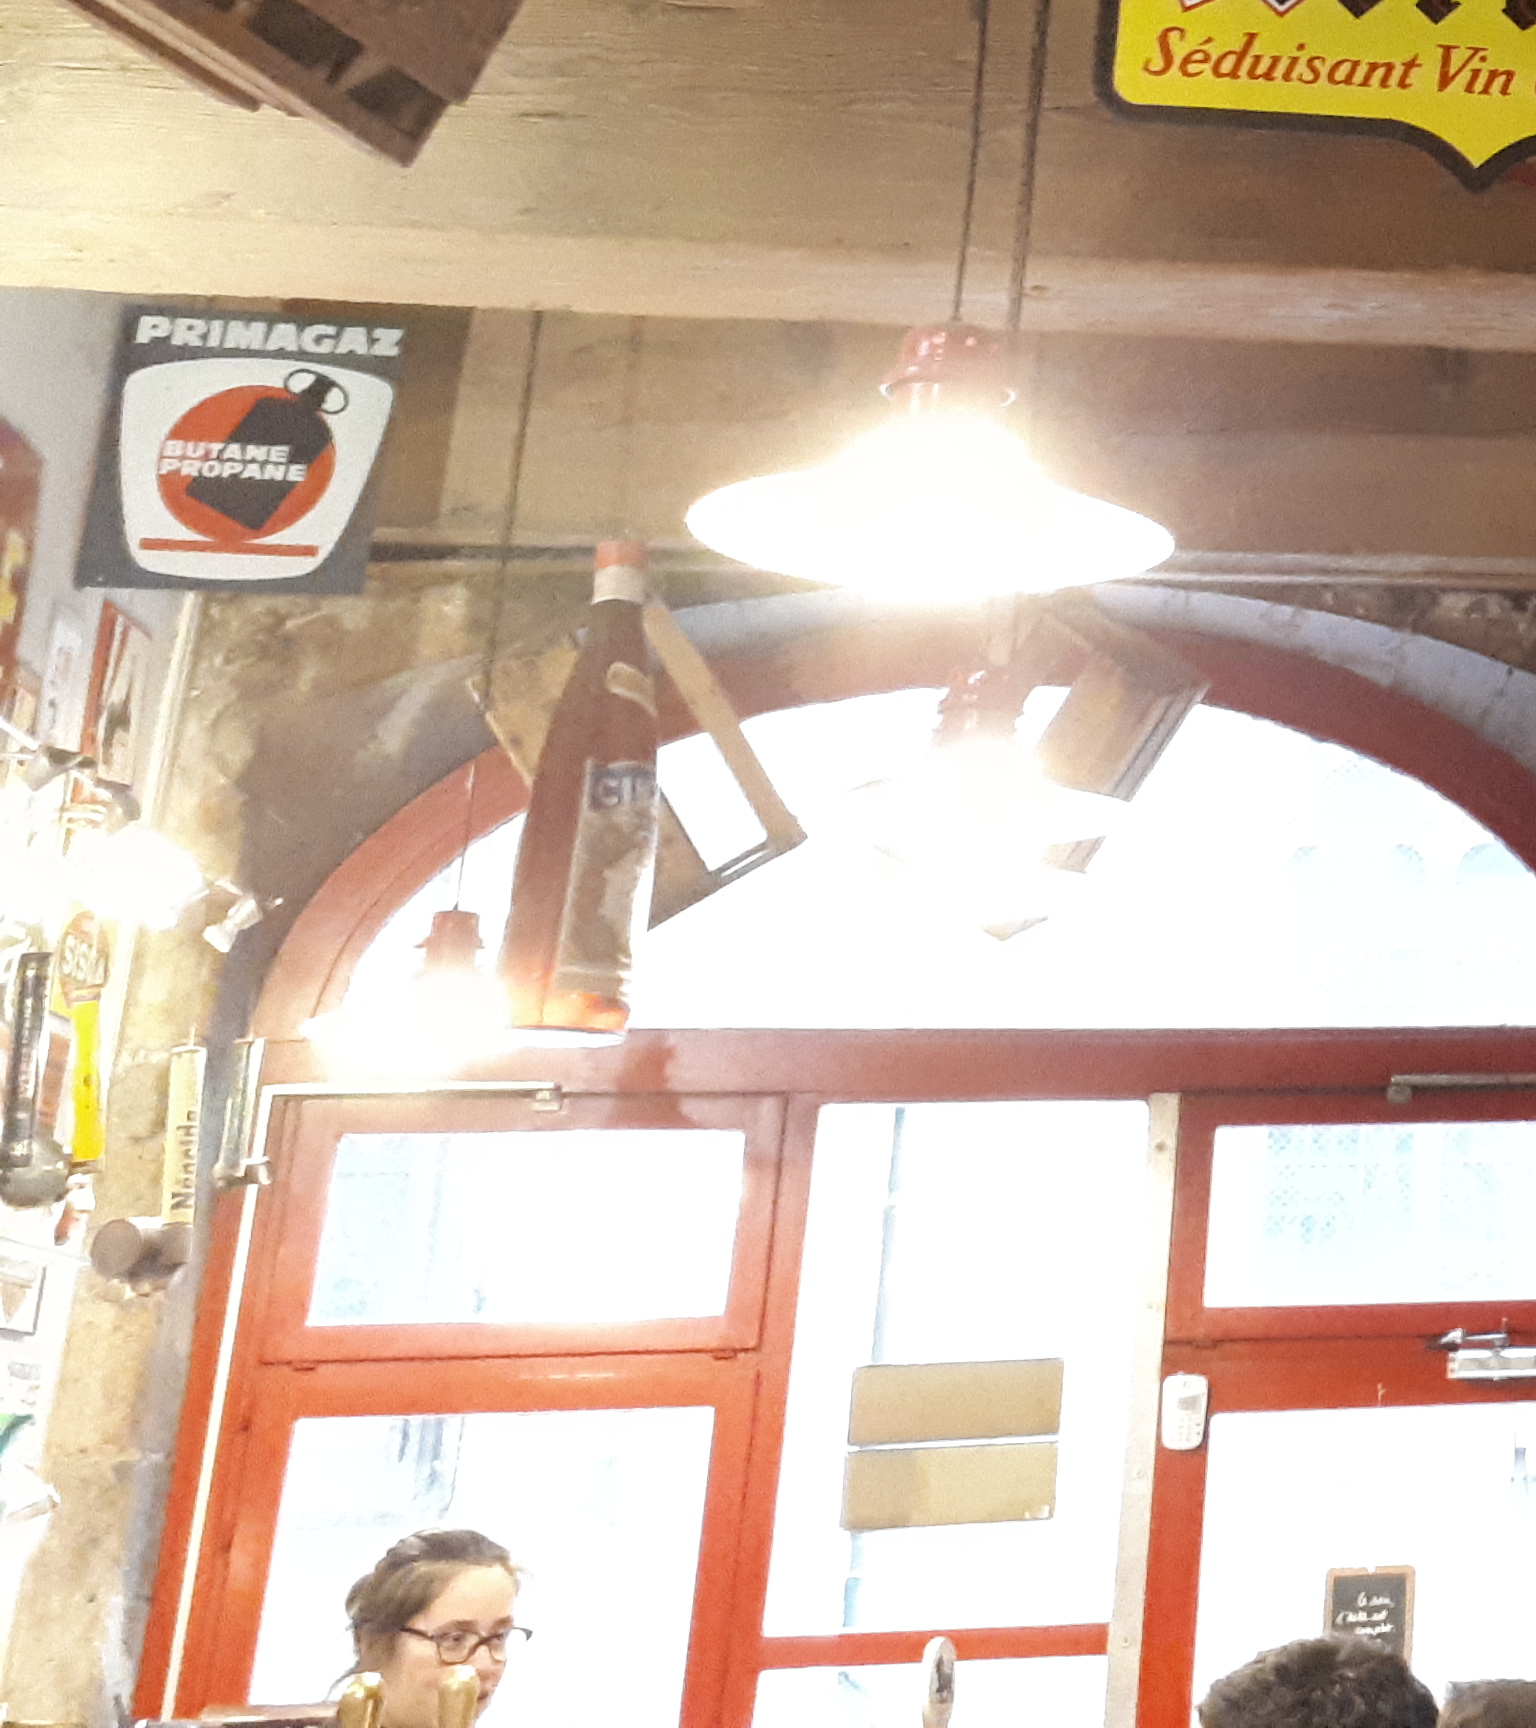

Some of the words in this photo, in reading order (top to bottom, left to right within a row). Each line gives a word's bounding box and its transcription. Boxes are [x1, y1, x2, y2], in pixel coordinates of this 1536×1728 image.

[1144, 27, 1424, 90] Séduisant
[1434, 46, 1516, 99] Vin
[135, 315, 405, 357] PRIMAGAZ
[162, 440, 290, 462] BUTANE
[159, 458, 307, 481] PROPANE
